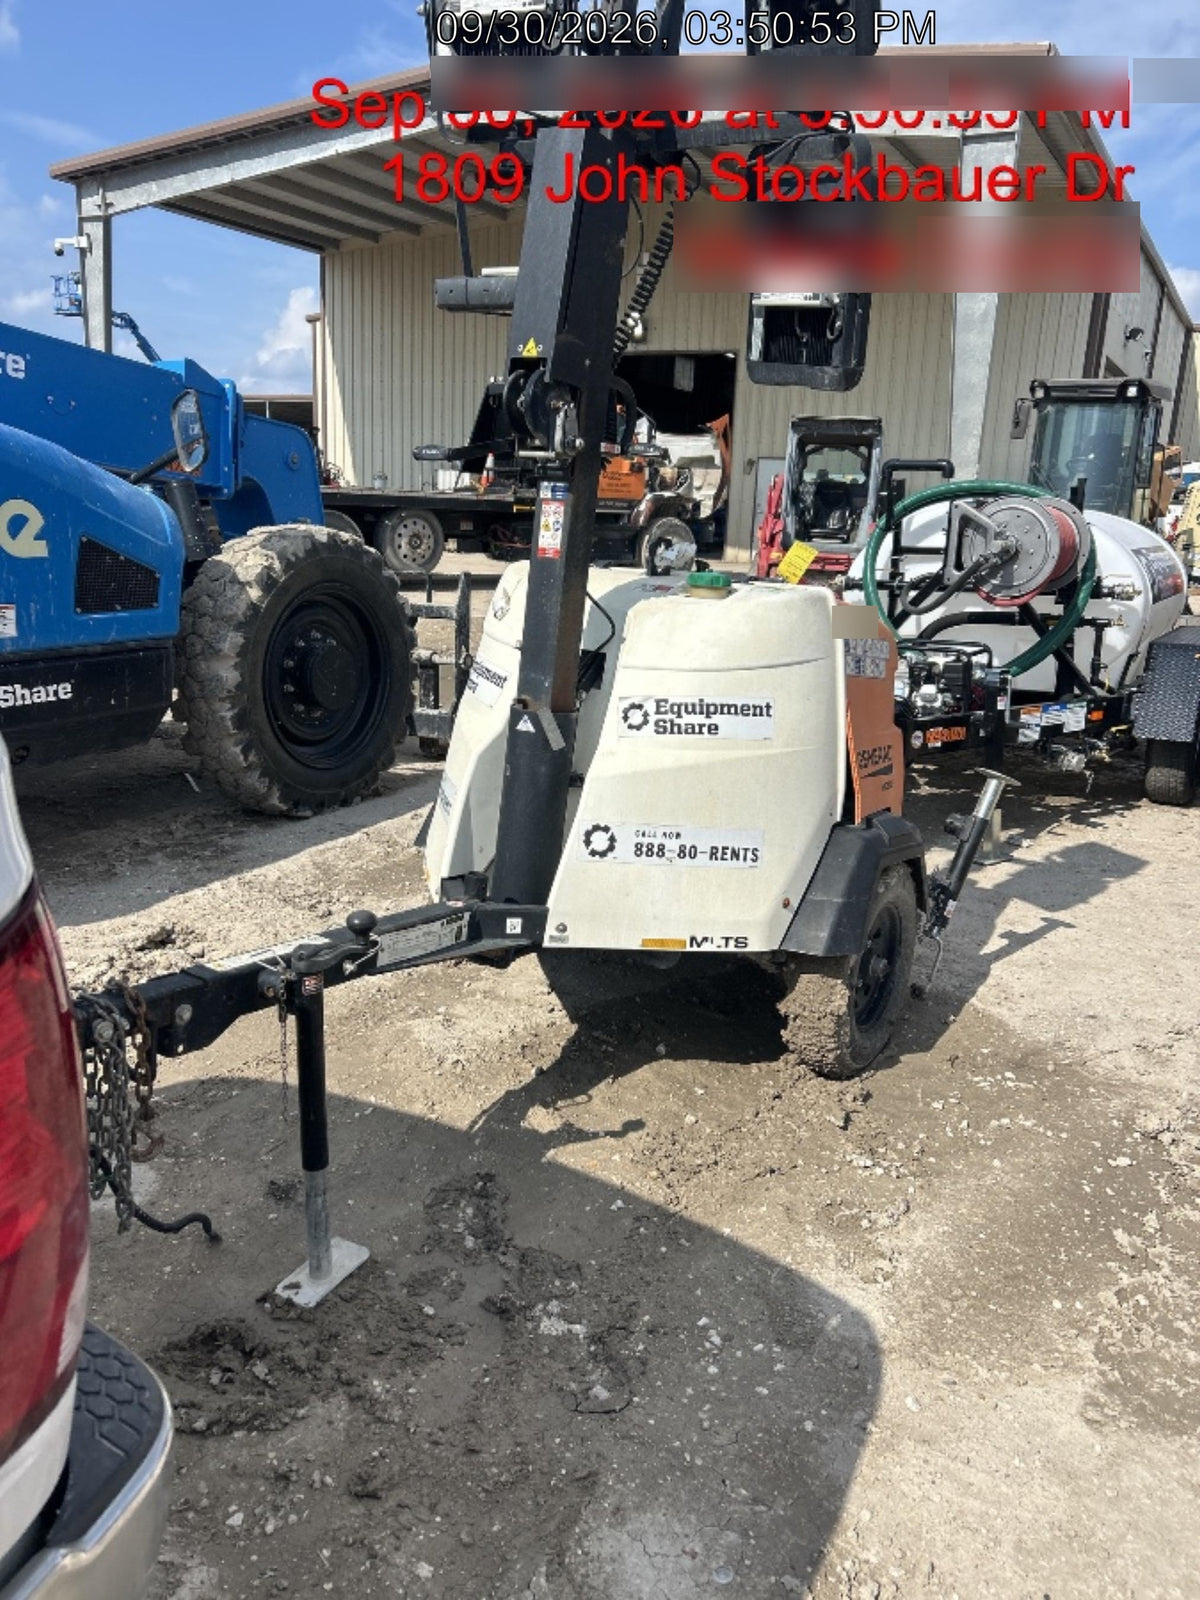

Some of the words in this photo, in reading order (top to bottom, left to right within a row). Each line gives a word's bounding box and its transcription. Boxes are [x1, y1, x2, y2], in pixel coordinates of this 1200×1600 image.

[0, 682, 74, 708] Share
[653, 698, 773, 719] Equipment
[653, 718, 720, 735] Share
[633, 841, 761, 863] 888-80-RENTS
